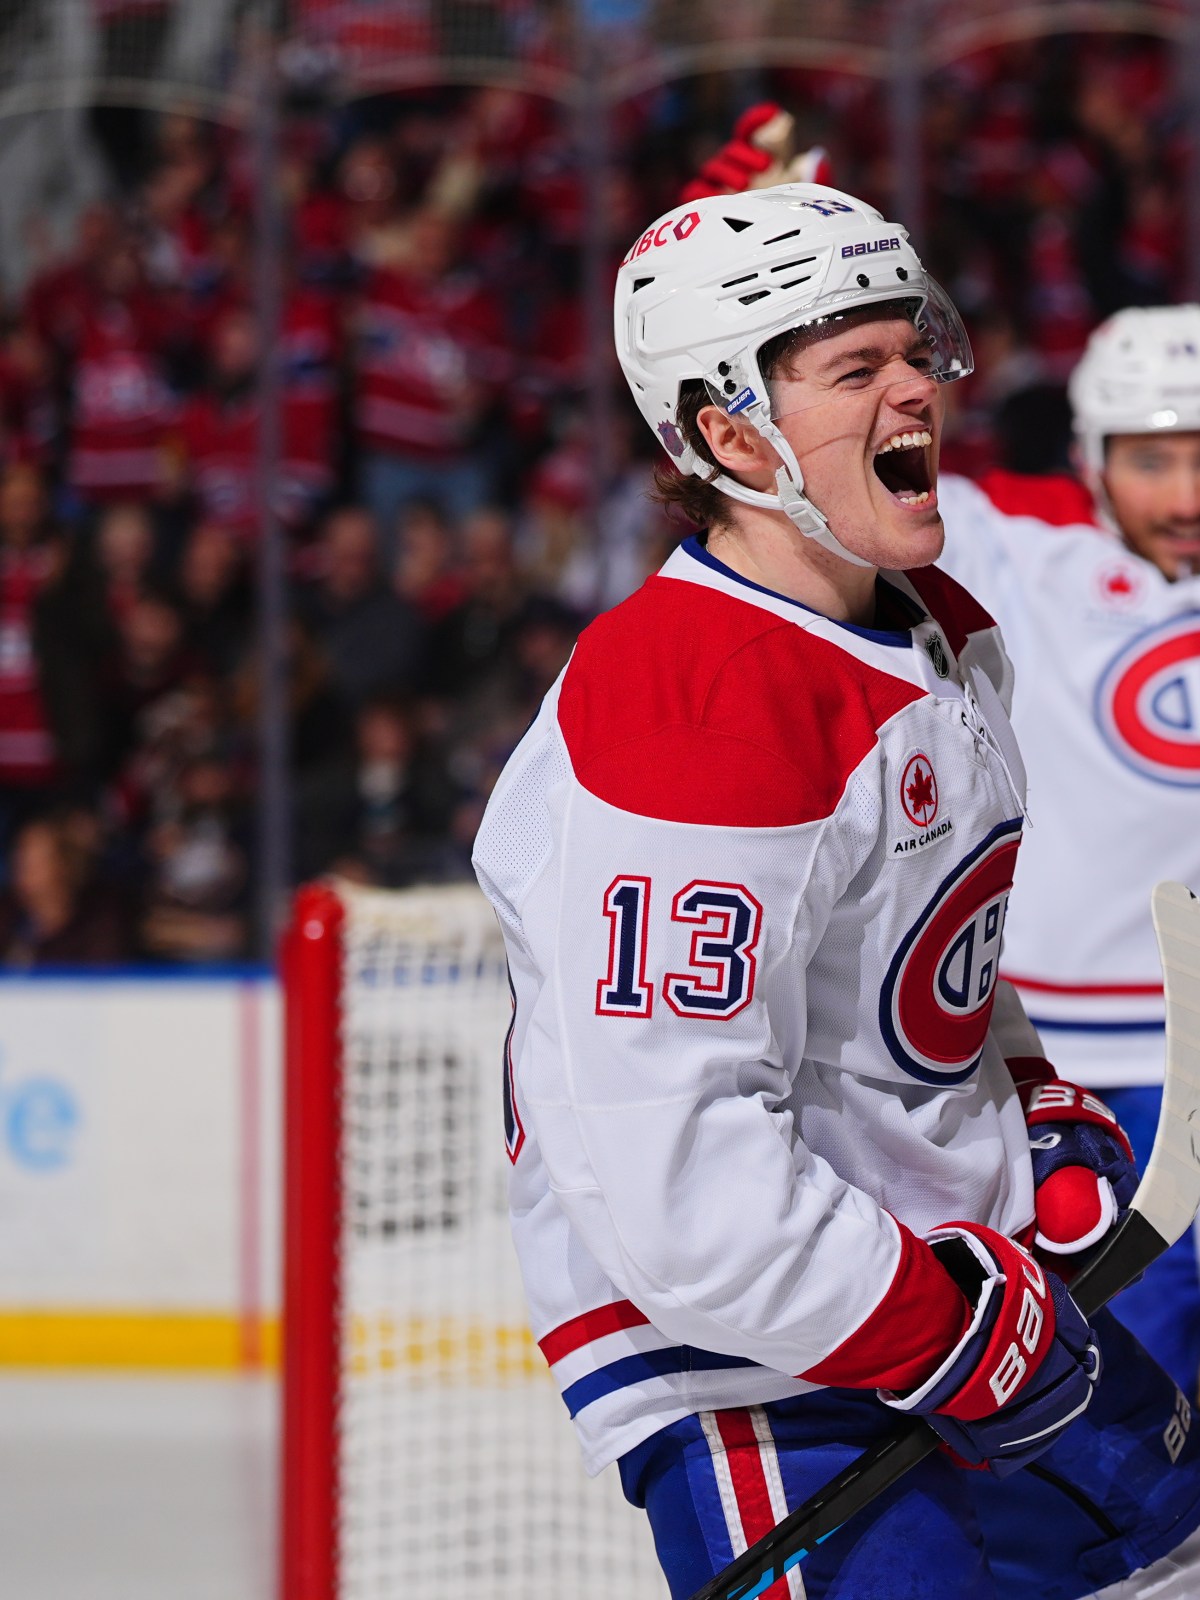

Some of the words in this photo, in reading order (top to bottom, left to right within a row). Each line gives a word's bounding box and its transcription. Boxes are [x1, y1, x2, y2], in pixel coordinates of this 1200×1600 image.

[841, 238, 901, 259] BAUER
[894, 838, 917, 853] AIR
[918, 820, 953, 847] CANADA
[595, 874, 763, 1022] 13
